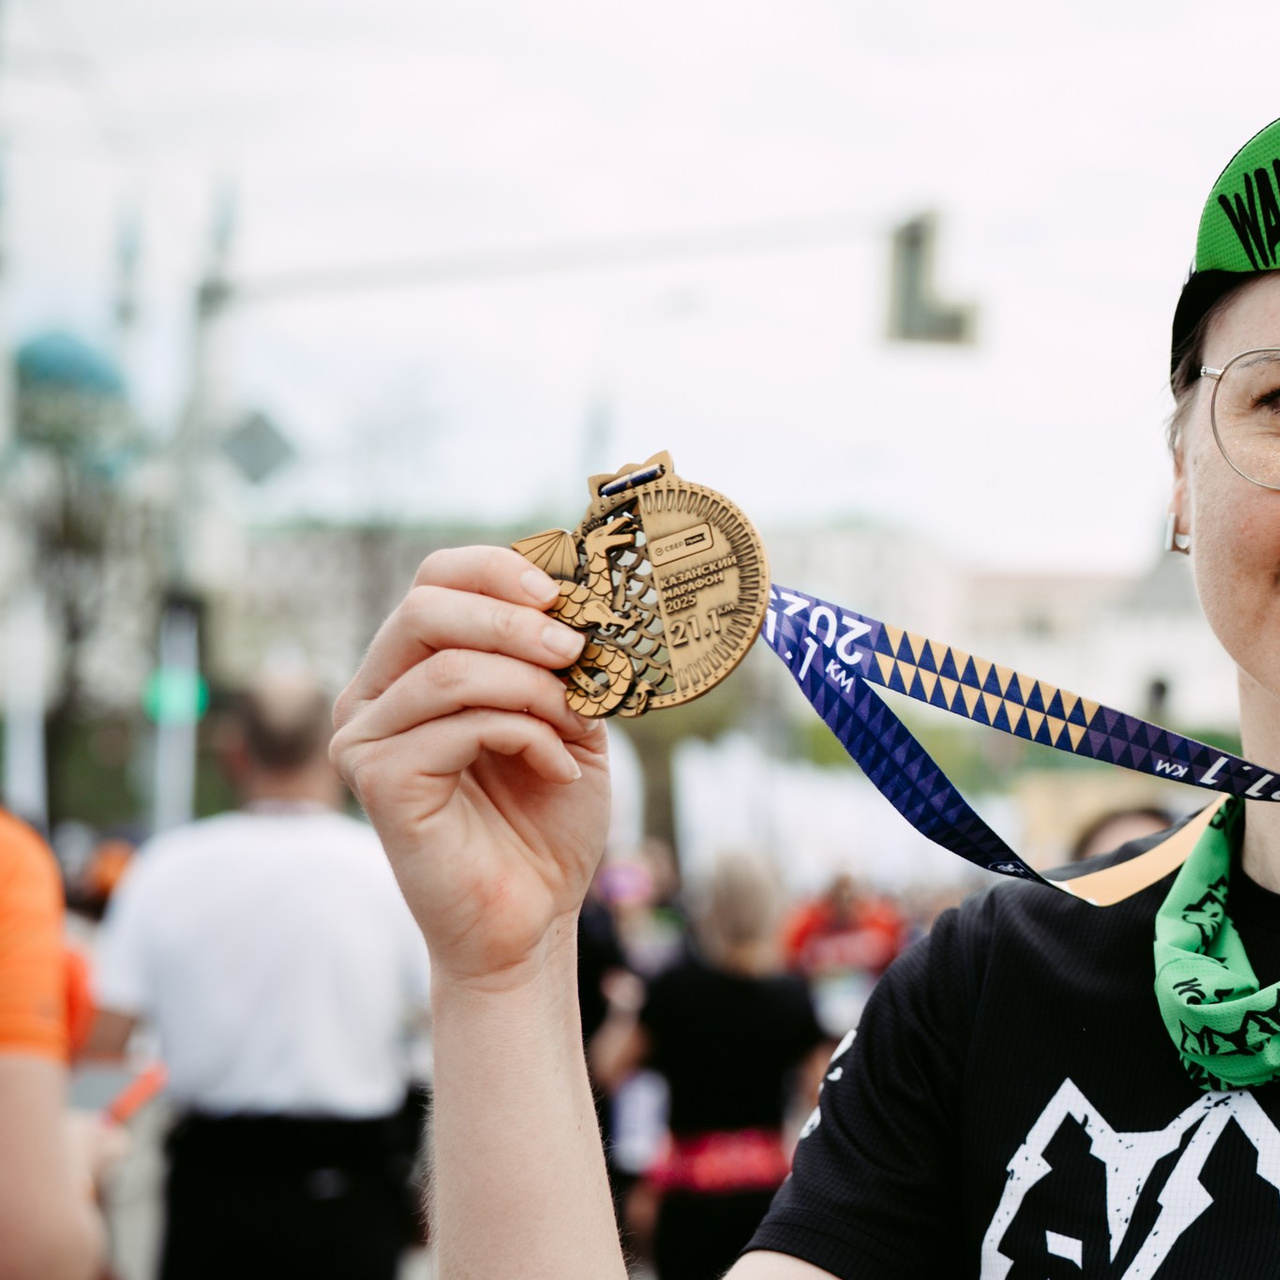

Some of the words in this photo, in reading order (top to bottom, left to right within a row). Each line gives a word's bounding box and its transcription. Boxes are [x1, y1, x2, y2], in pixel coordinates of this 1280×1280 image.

[660, 554, 738, 589] КАЗАНСКИЙ
[662, 572, 724, 600] МАРАФОН
[666, 594, 697, 613] 2025
[670, 609, 720, 647] 21.1
[766, 608, 818, 681] 1.1
[769, 589, 872, 665] 202
